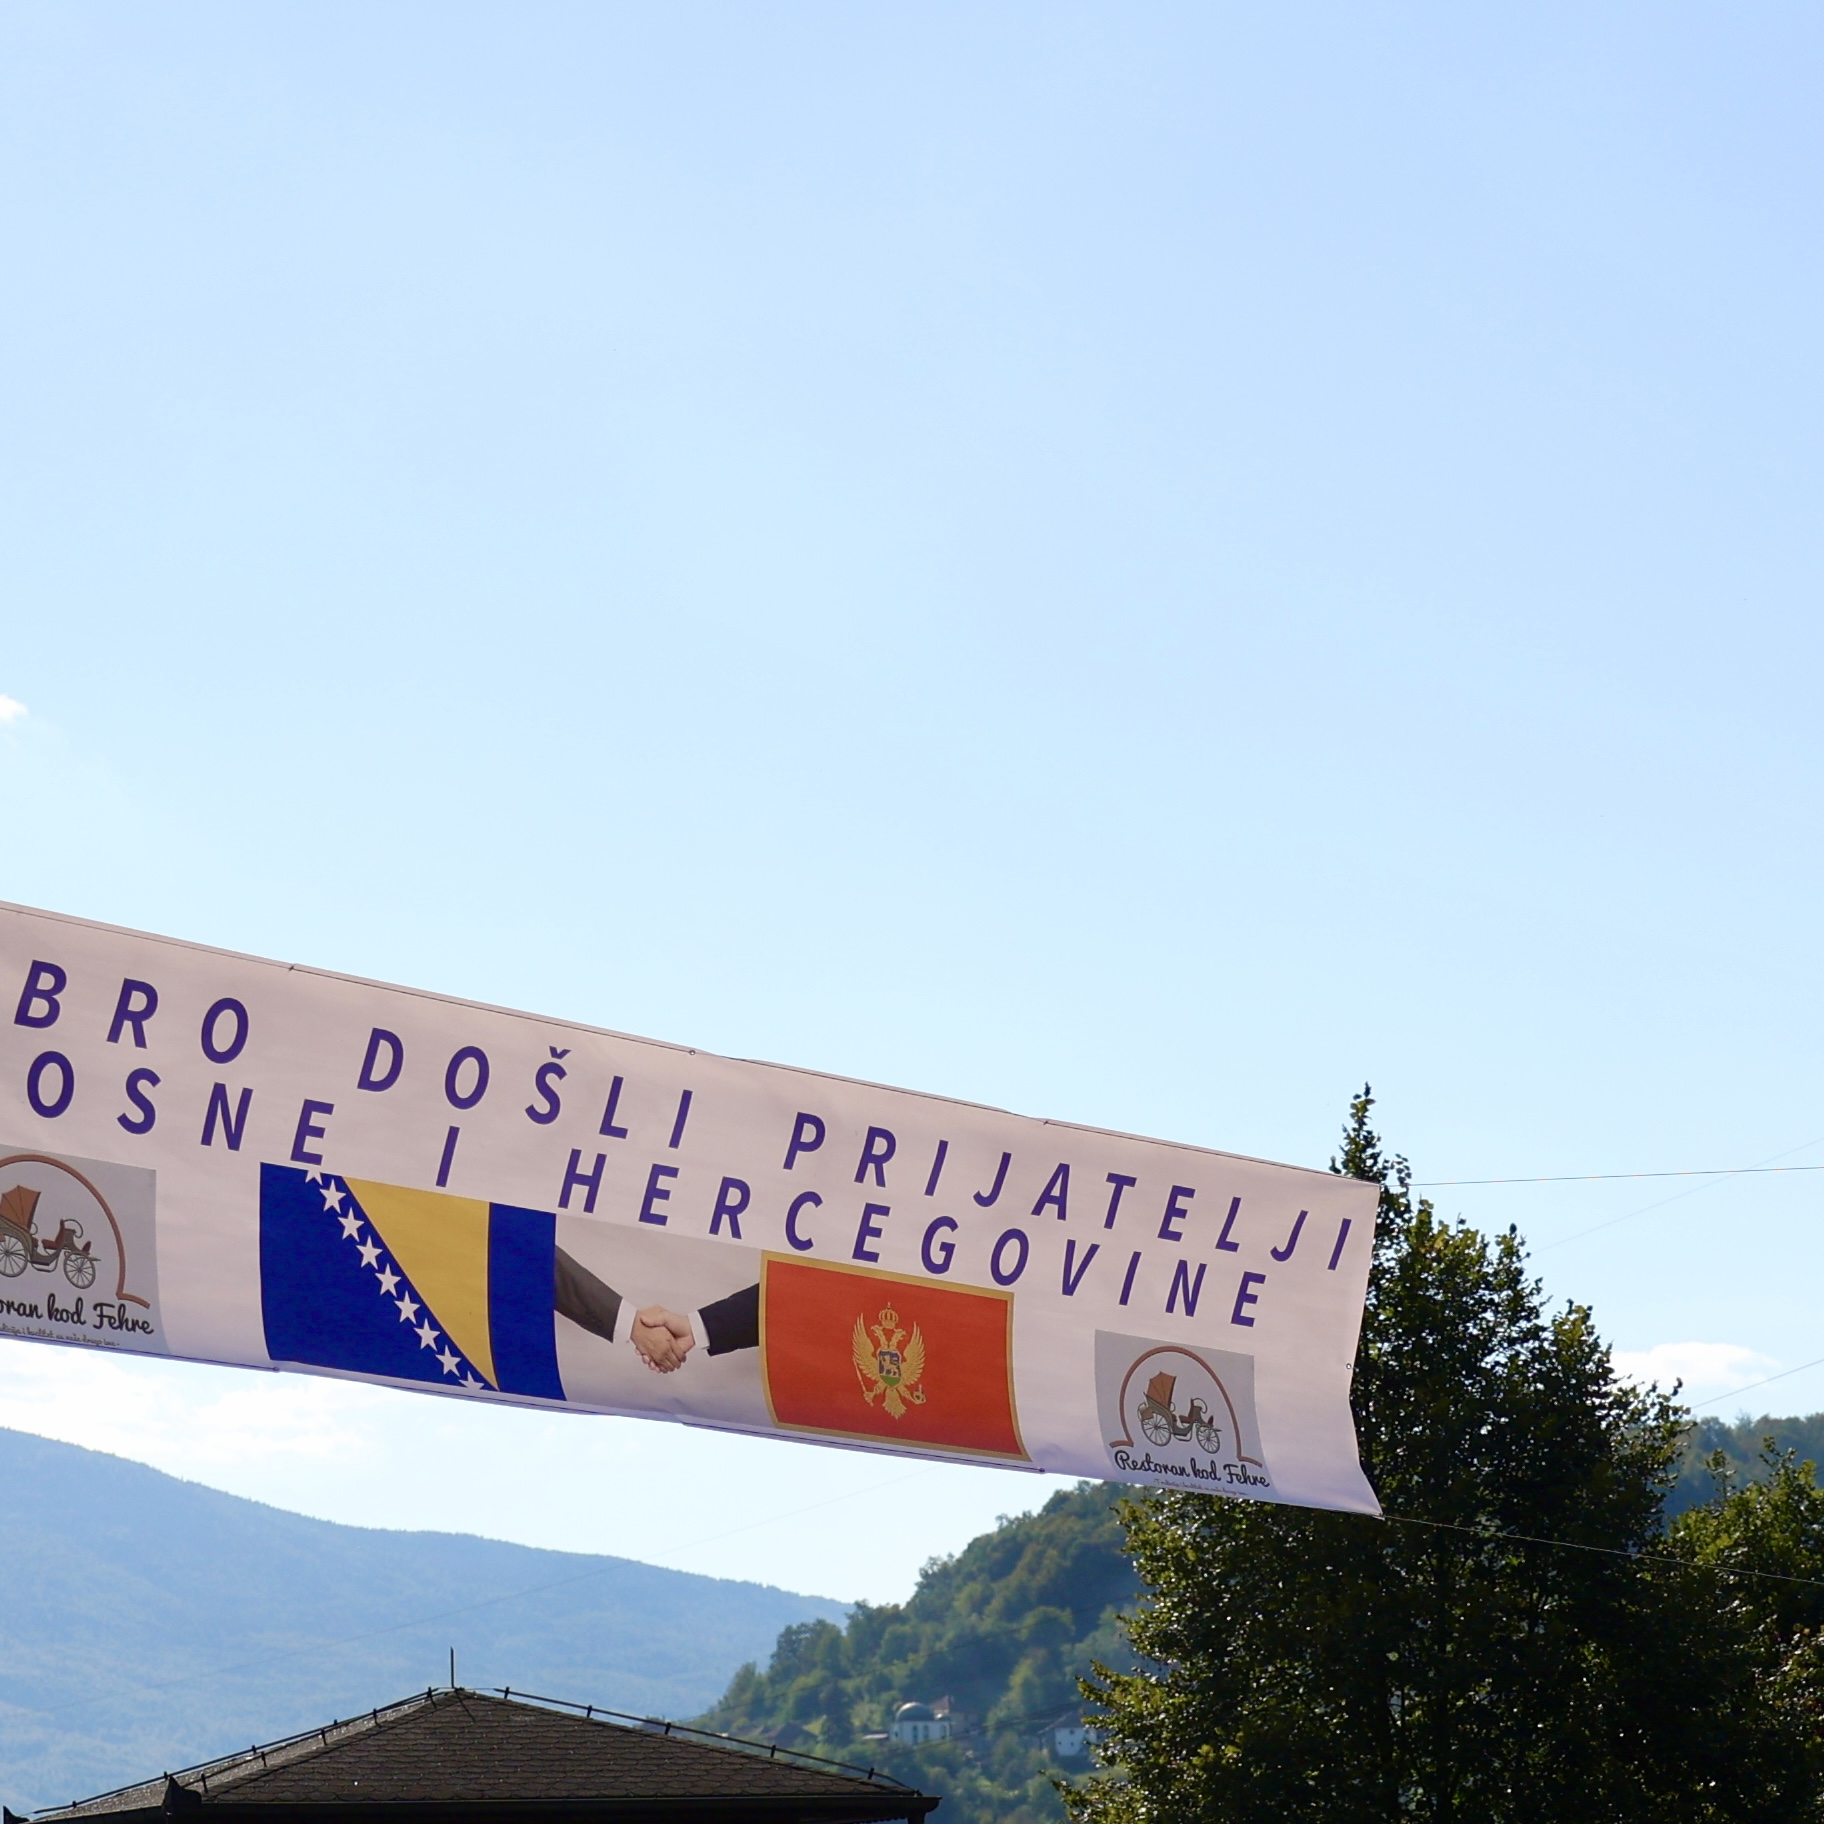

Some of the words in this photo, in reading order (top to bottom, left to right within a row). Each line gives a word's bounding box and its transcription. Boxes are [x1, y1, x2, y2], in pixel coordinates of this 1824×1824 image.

[357, 1029, 693, 1149] DOŠLI
[783, 1113, 1352, 1270] PRIJATELJI
[436, 1126, 460, 1187] I
[558, 1149, 1266, 1327] HERCEGOVINE
[47, 1292, 86, 1326] kod
[93, 1301, 154, 1335] Fehre
[1114, 1450, 1190, 1478] Restoran
[1190, 1457, 1222, 1482] kod
[1222, 1463, 1270, 1488] Fehre
